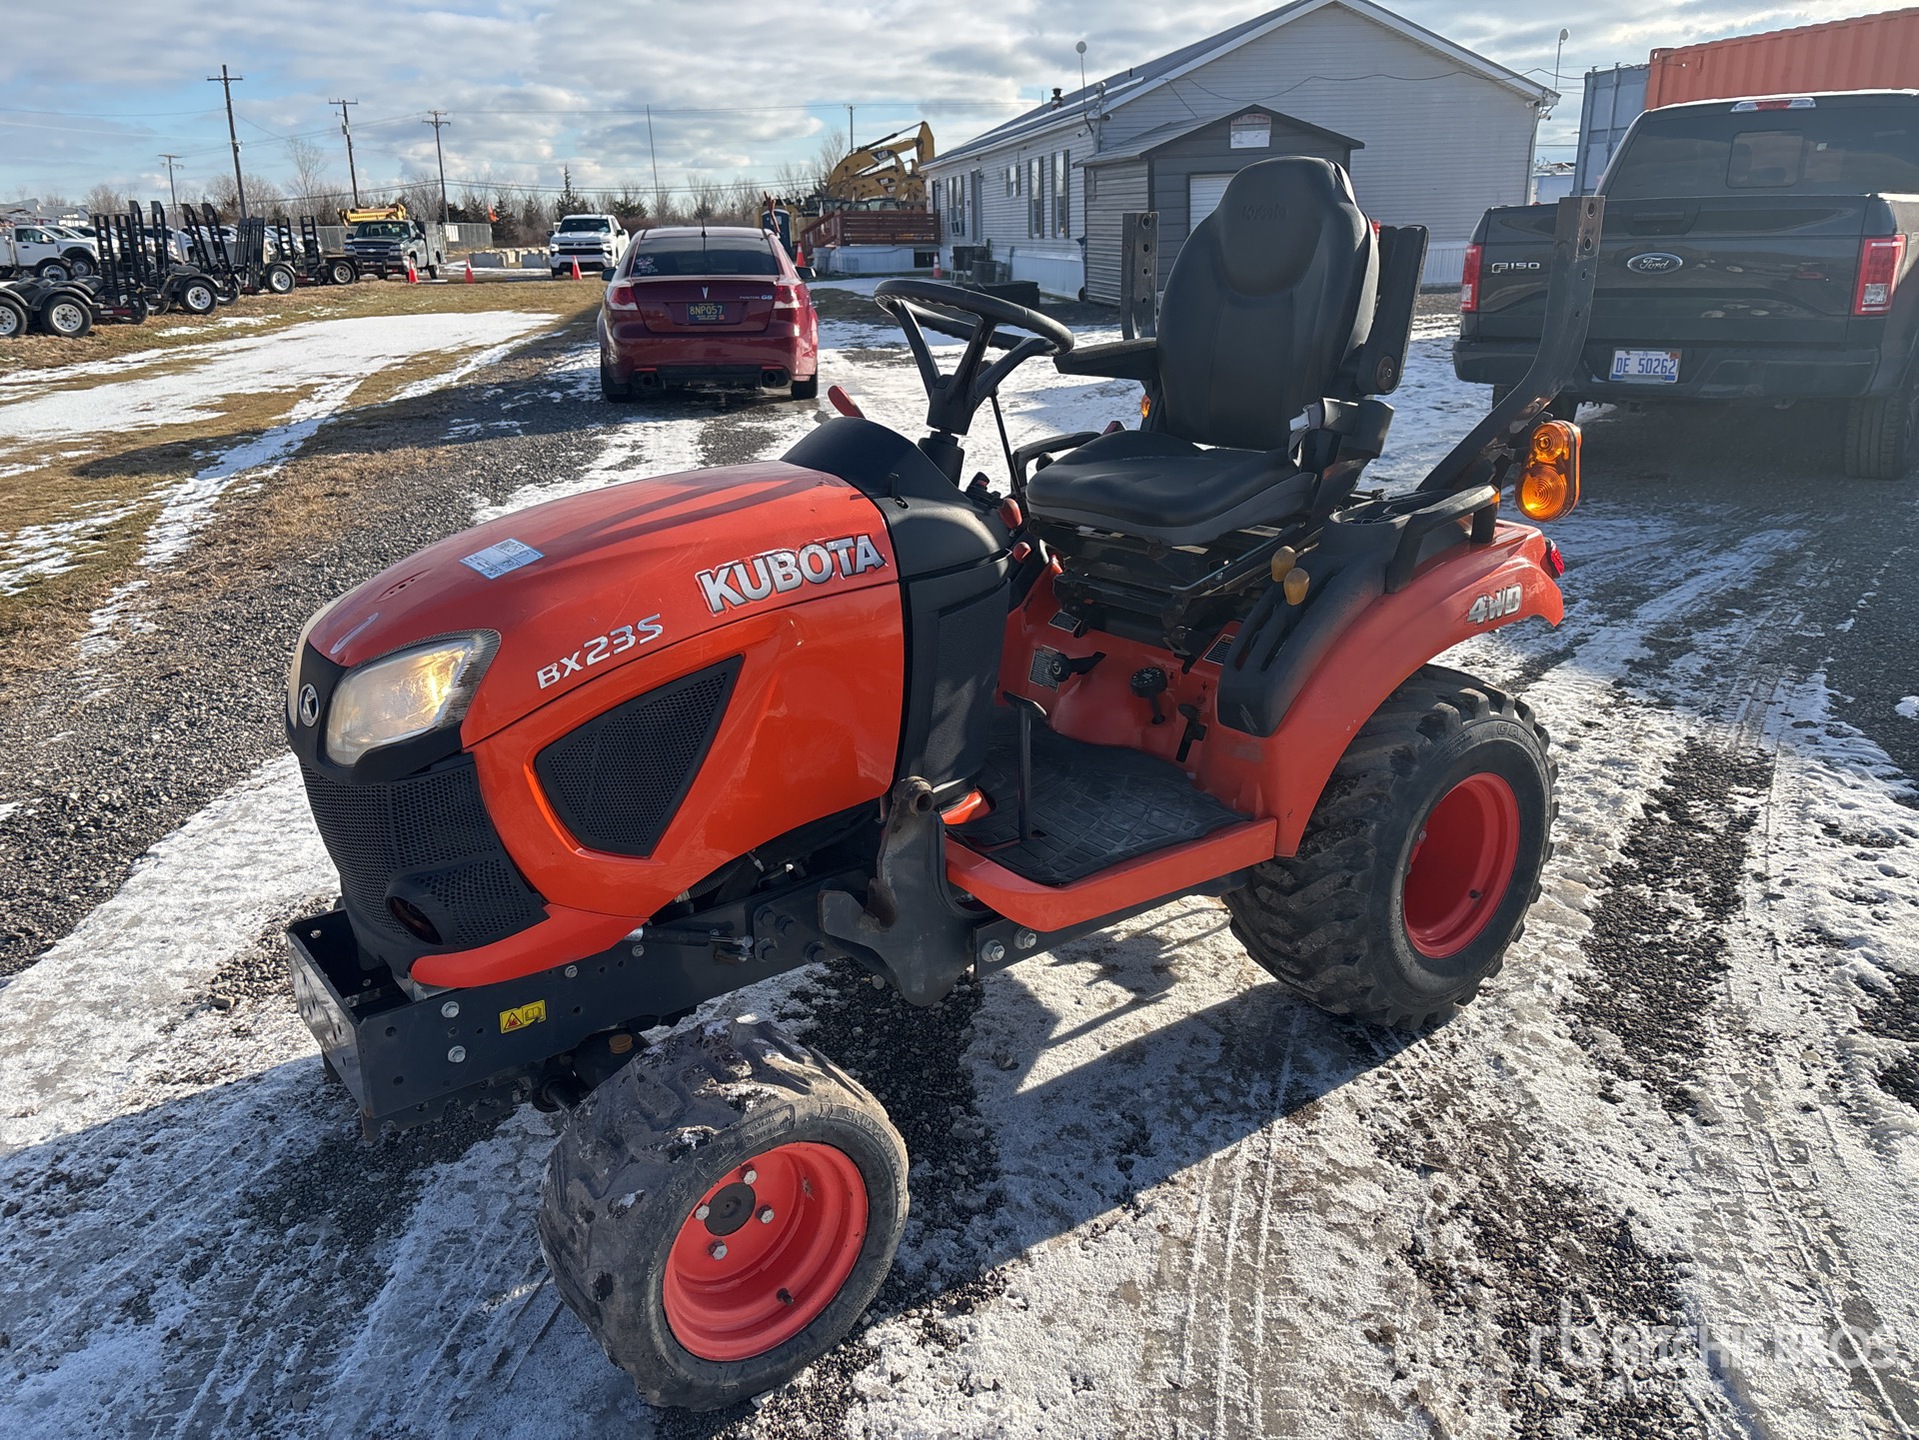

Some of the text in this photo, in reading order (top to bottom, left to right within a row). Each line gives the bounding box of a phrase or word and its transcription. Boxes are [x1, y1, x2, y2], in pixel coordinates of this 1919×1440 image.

[1639, 256, 1670, 270] Ford
[1615, 357, 1677, 375] DE 50262
[697, 533, 886, 614] KUBOTA
[1466, 584, 1522, 624] 4WD
[536, 612, 664, 690] BX23S
